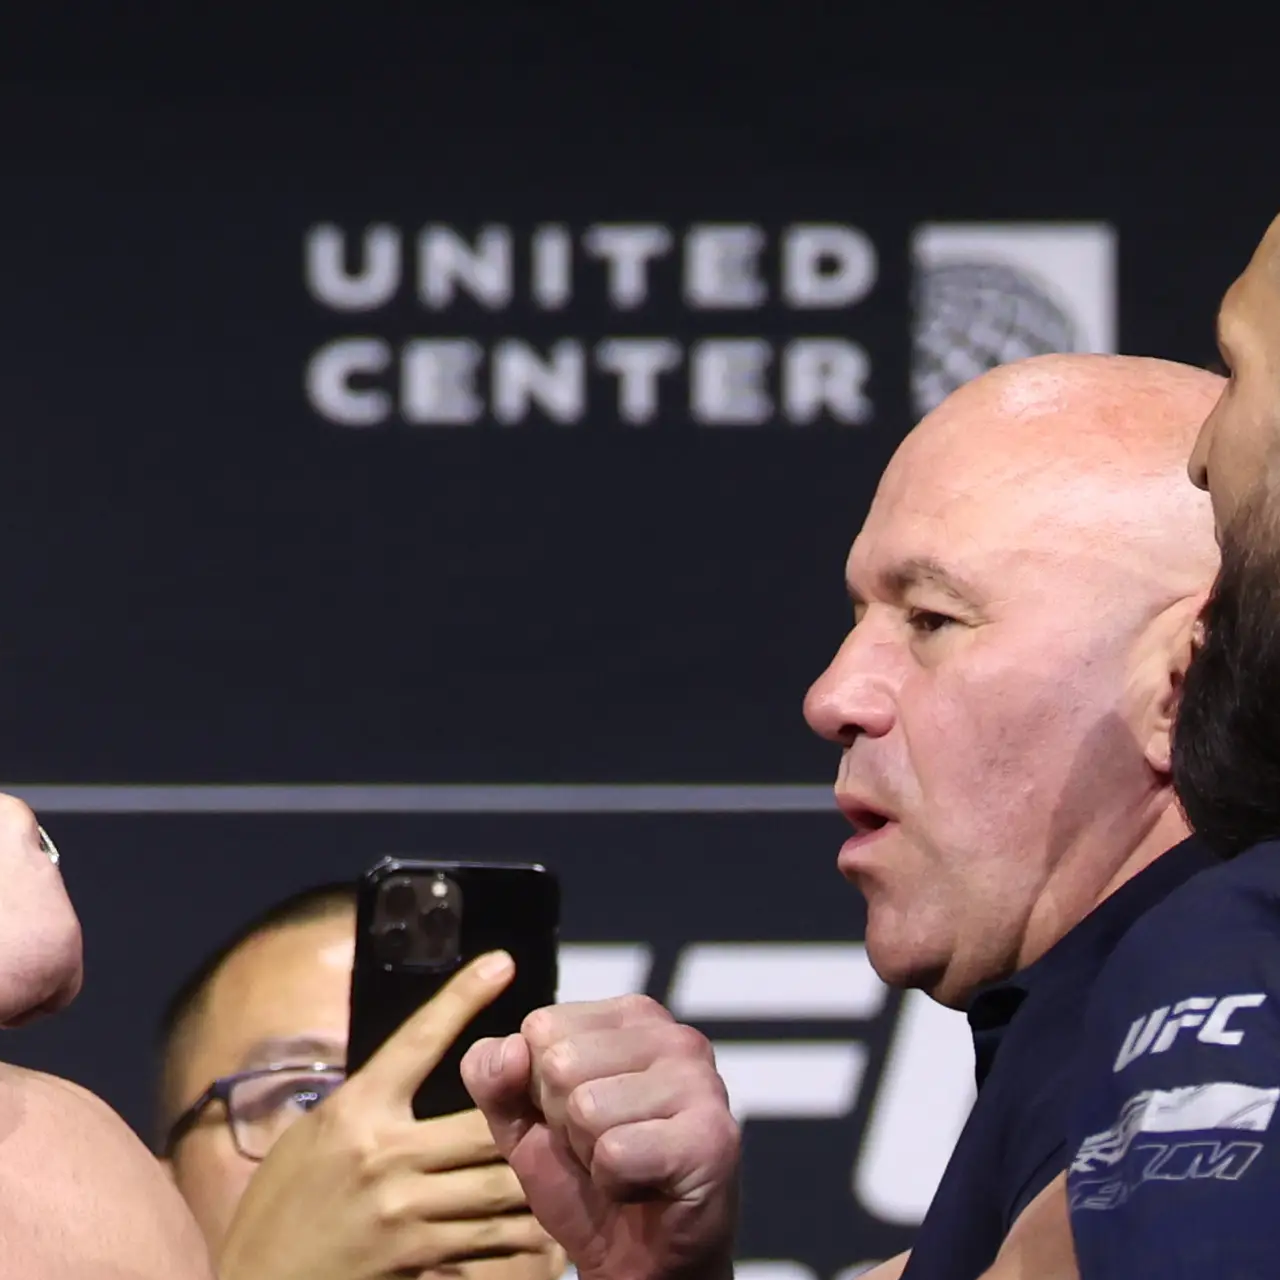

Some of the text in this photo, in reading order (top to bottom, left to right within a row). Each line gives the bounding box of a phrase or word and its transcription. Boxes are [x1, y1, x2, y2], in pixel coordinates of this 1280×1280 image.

[310, 227, 874, 308] UNITED
[310, 341, 872, 424] CENTER
[1114, 993, 1266, 1072] UFC
